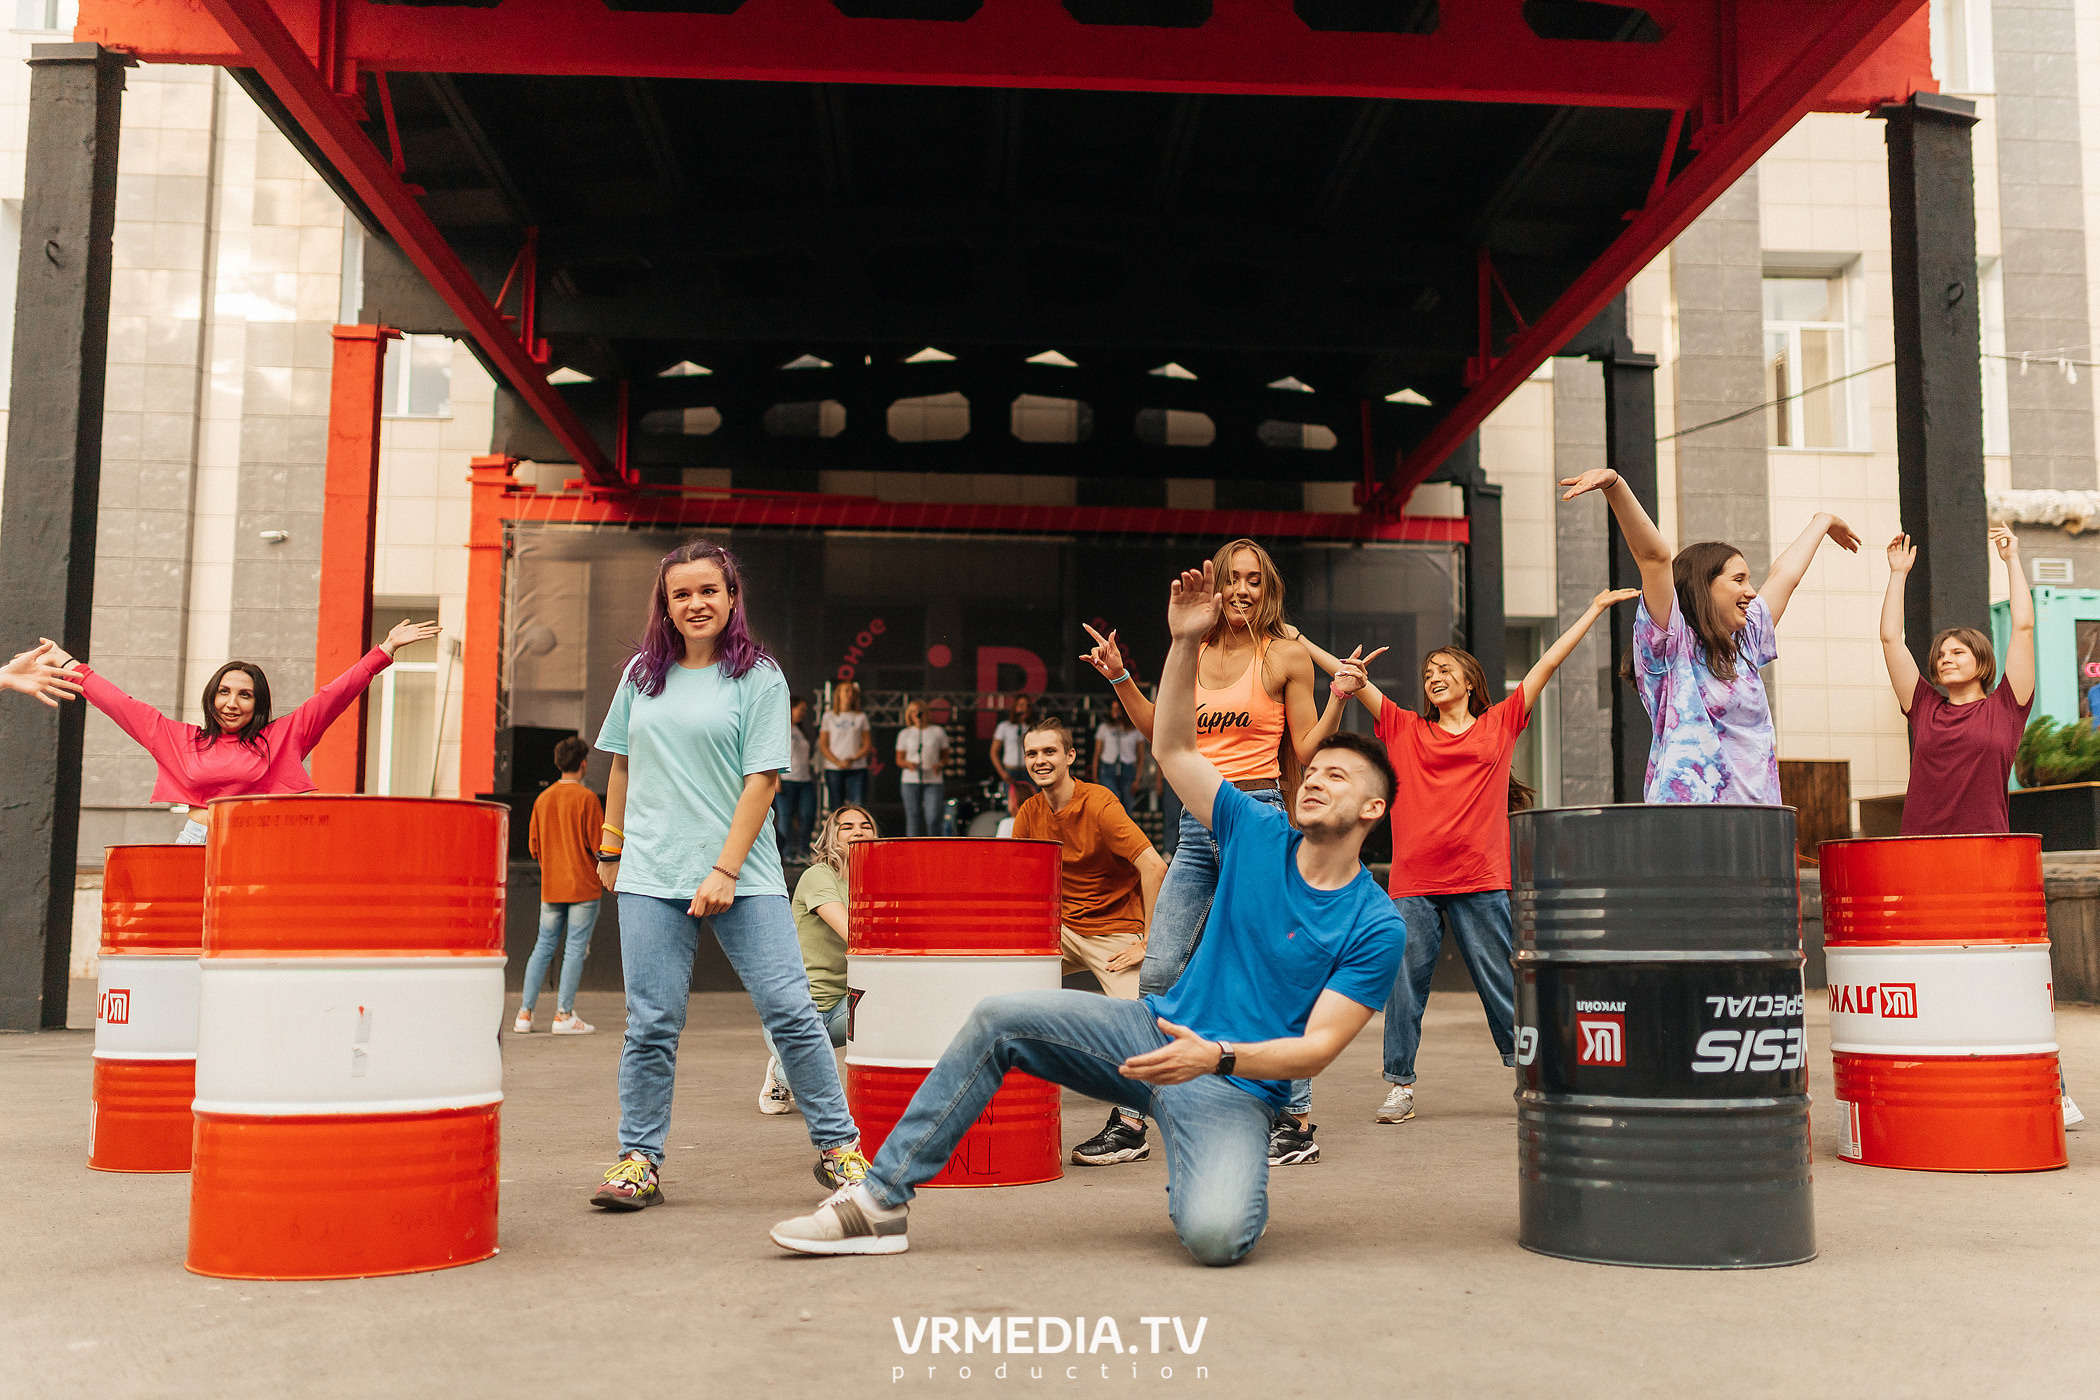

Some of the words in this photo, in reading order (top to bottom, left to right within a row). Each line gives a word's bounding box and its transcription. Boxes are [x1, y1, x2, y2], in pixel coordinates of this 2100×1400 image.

[1575, 1000, 1627, 1014] ЛУКОЙЛ
[1705, 993, 1806, 1018] SPECIAL
[1828, 985, 1877, 1015] ЛУК
[1690, 1027, 1805, 1072] ESIS
